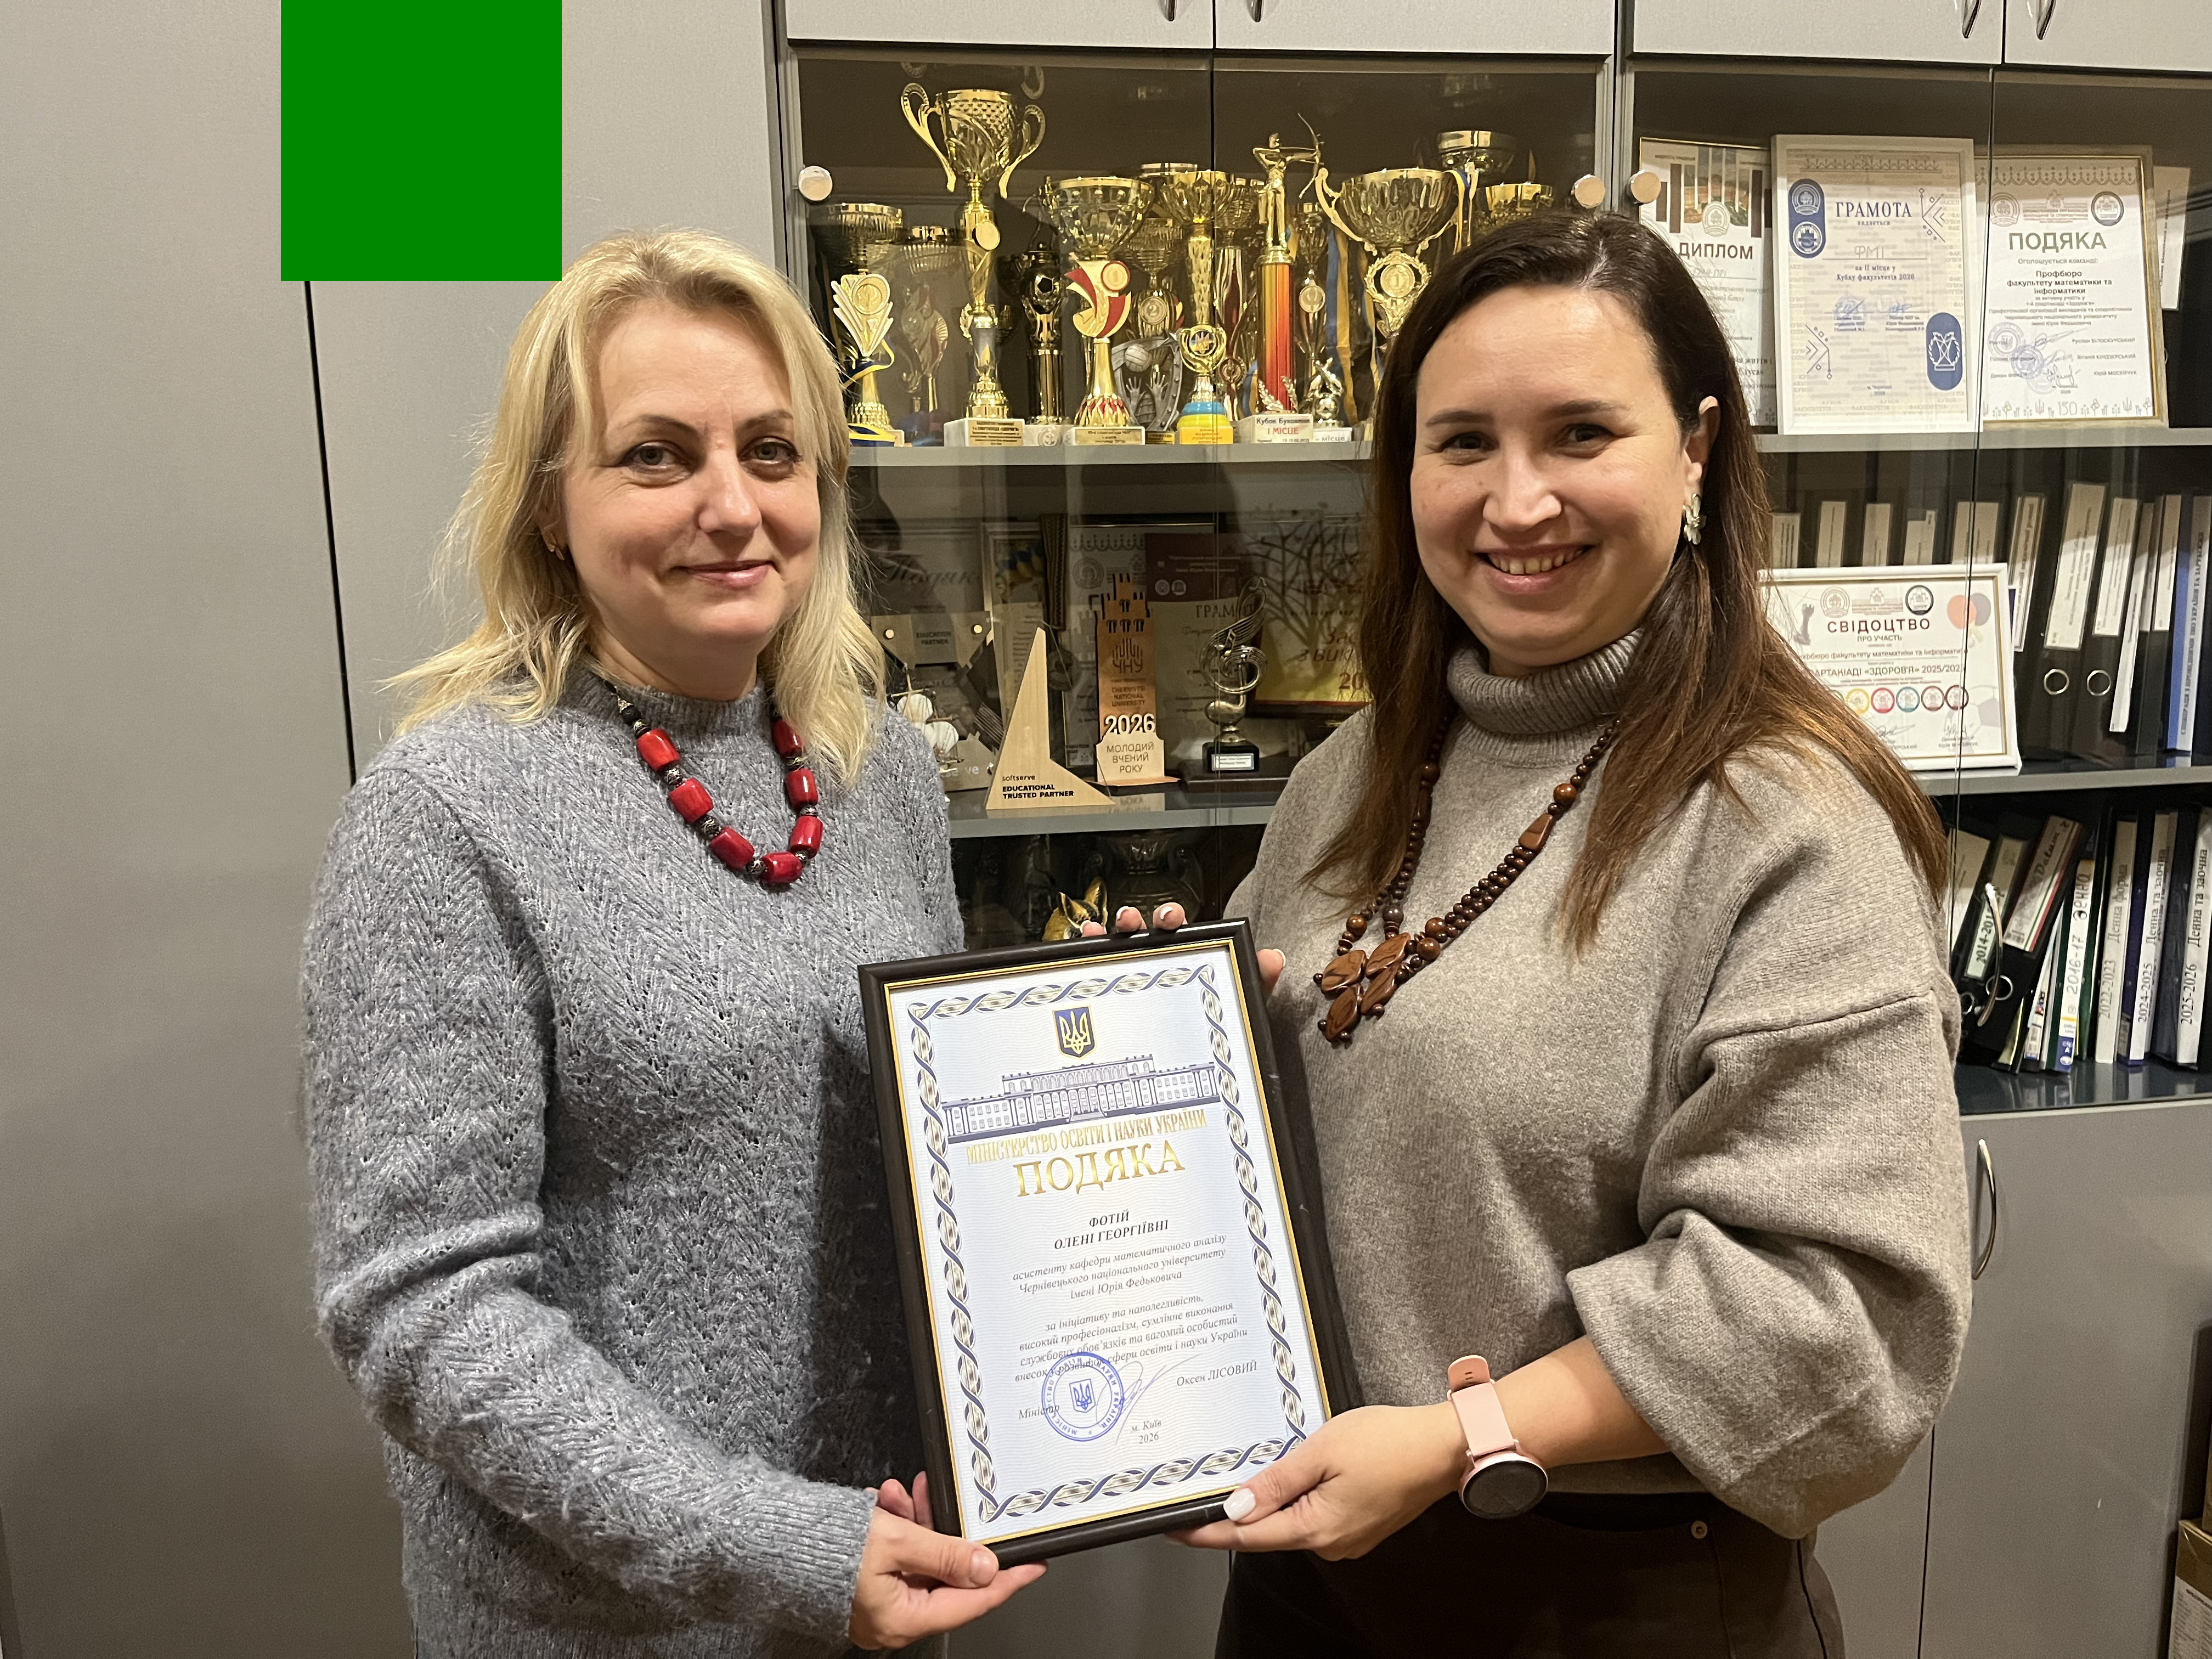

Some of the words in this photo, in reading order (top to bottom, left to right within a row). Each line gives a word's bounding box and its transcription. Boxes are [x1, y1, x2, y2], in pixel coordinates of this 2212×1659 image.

[1836, 201, 1912, 218] ГРАМОТА
[1679, 242, 1753, 259] ДИПЛОМ
[2009, 232, 2107, 253] ПОДЯКА
[1858, 274, 1897, 282] факультетів
[2036, 270, 2082, 278] Профбюро
[1273, 427, 1299, 435] МІСЦЕ
[1827, 618, 1930, 634] СВІДОЦТВО
[1831, 651, 1871, 659] факультету
[1872, 650, 1914, 658] математики
[1810, 667, 1861, 677] АРТАКІАДІ
[1105, 713, 1155, 735] 2026
[1107, 741, 1154, 753] МОЛОДИЙ
[1113, 752, 1149, 764] ВЧЕНИЙ
[1119, 764, 1143, 774] РОКУ
[2113, 864, 2129, 901] форма
[2154, 849, 2166, 889] заочна
[2196, 849, 2208, 889] заочна
[2153, 892, 2160, 904] та
[2195, 893, 2204, 906] та
[2108, 906, 2123, 944] Денна
[2146, 907, 2159, 945] Денна
[2187, 909, 2202, 948] Денна
[2066, 935, 2084, 996] 2016-17
[2099, 961, 2115, 1019] 2022-2023
[2138, 963, 2153, 1023] 2024-2025
[2181, 963, 2197, 1025] 2025-2026
[967, 1132, 1057, 1165] МІНІСТЕРСТВО
[1060, 1126, 1105, 1150] ОСВІТИ
[1114, 1118, 1153, 1142] НАУКИ
[1155, 1108, 1207, 1133] УКРАЇНИ
[1013, 1139, 1186, 1197] ПОДЯКА
[1089, 1209, 1130, 1228] ФОТІЙ
[1054, 1233, 1094, 1250] ОЛЕНІ
[1098, 1219, 1169, 1243] ГЕОРГІЇВНІ
[1012, 1263, 1067, 1280] асистенту
[1070, 1255, 1111, 1274] кафедри
[1113, 1242, 1191, 1263] математичного
[1193, 1234, 1227, 1248] аналізу
[1019, 1274, 1088, 1294] Чернівецького
[1091, 1261, 1159, 1281] національного
[1161, 1248, 1226, 1268] університету
[1098, 1282, 1123, 1295] Юрія
[1126, 1272, 1182, 1288] Федьковича
[1019, 1334, 1058, 1352] високий
[1061, 1320, 1139, 1345] професіоналізм,
[1142, 1313, 1183, 1329] сумлінне
[1185, 1302, 1234, 1318] виконання
[1045, 1323, 1056, 1331] за
[1113, 1309, 1126, 1318] та
[1128, 1295, 1204, 1317] наполегливість,
[1020, 1347, 1074, 1367] службових
[1129, 1334, 1142, 1344] та
[1146, 1323, 1185, 1340] вагомий
[1187, 1313, 1238, 1333] особистий
[1108, 1351, 1138, 1365] сфери
[1140, 1343, 1172, 1356] освіти
[1175, 1341, 1179, 1350] і
[1181, 1336, 1208, 1350] науки
[1211, 1328, 1248, 1344] України
[1018, 1405, 1060, 1420] Міністр
[1177, 1374, 1206, 1387] Оксен
[1208, 1359, 1257, 1381] ЛІСОВИЙ
[1139, 1431, 1159, 1444] 2026
[1143, 1419, 1162, 1431] Київ
